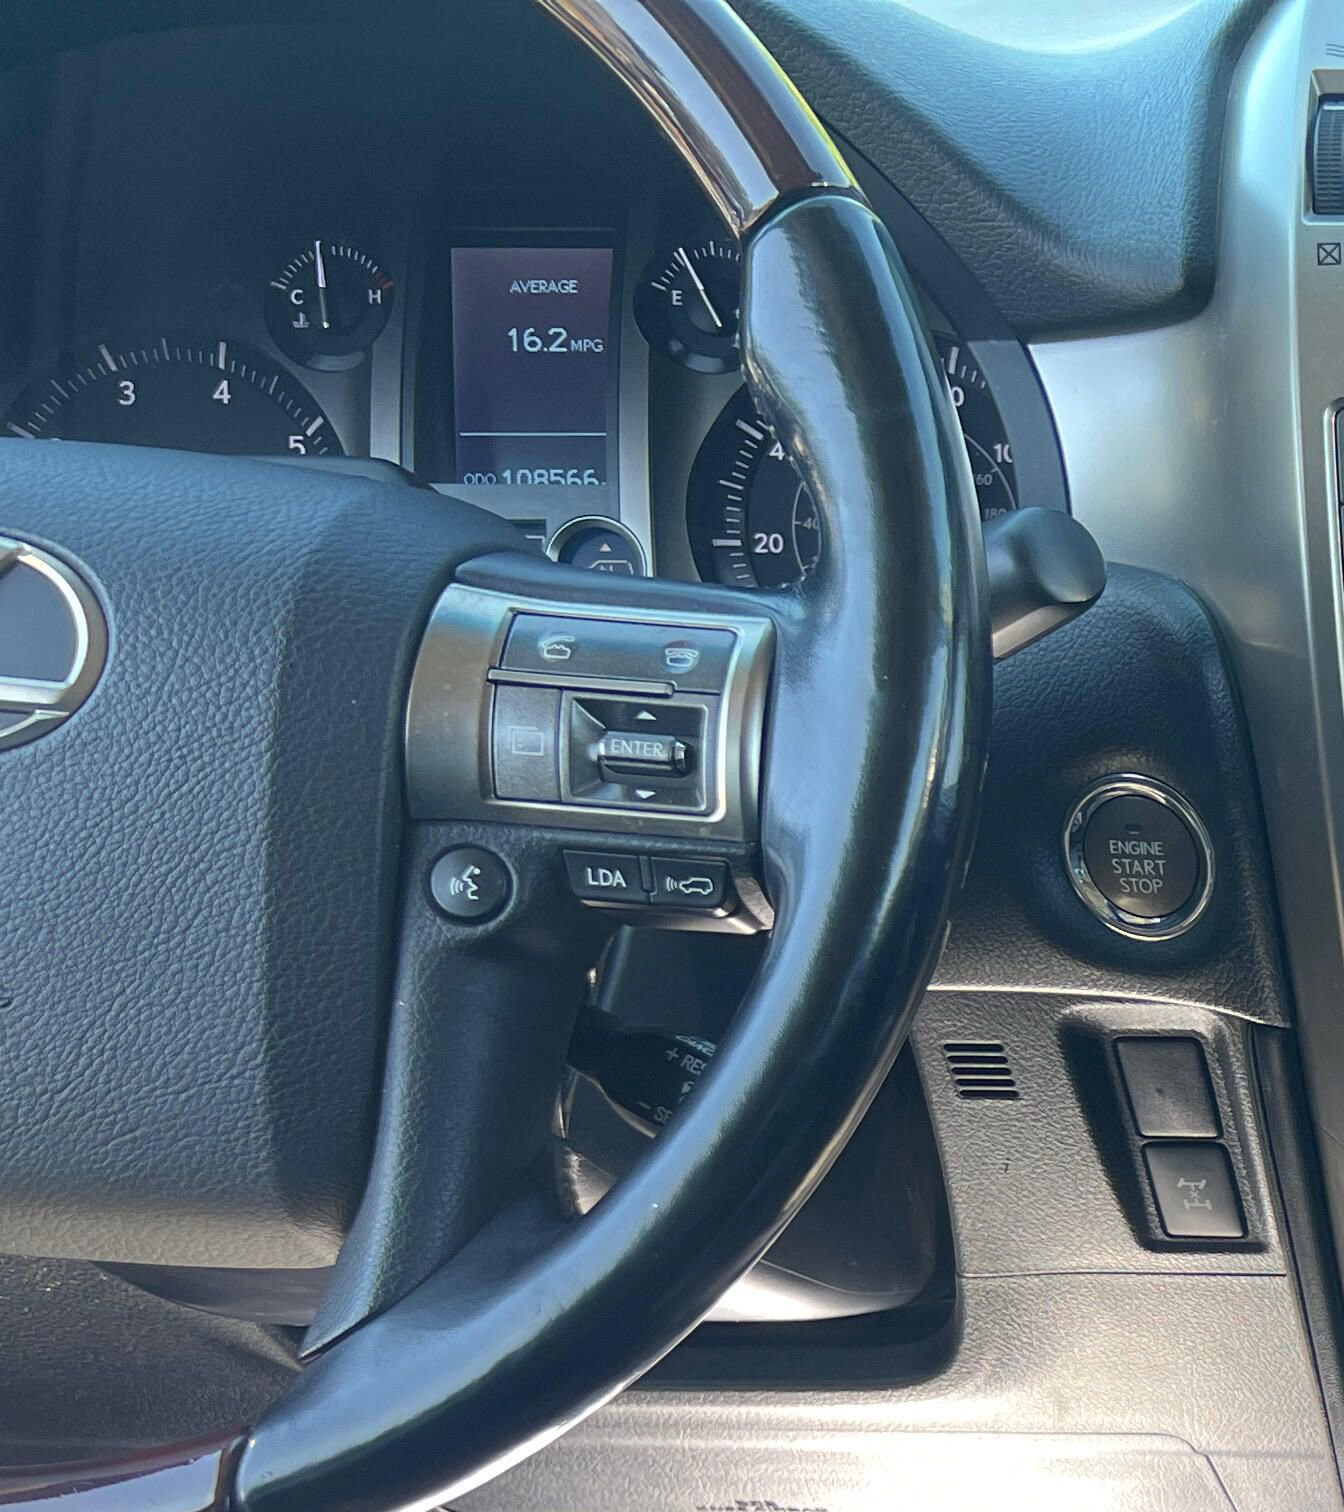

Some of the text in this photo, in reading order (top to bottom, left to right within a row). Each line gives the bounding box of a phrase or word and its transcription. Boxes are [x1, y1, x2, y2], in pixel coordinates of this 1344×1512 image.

[509, 279, 579, 294] AVERAGE
[290, 288, 305, 305] C
[367, 288, 382, 305] H
[671, 290, 683, 306] E
[507, 327, 605, 352] 16.2 MPG
[118, 380, 137, 406] 3
[212, 379, 231, 405] 4
[288, 434, 306, 456] 5
[463, 472, 497, 485] ODO
[753, 532, 784, 554] 20
[609, 739, 664, 758] ENTER
[1108, 839, 1165, 857] ENGINE
[1111, 858, 1167, 876] START
[585, 867, 627, 888] LDA
[1119, 877, 1164, 895] STOP
